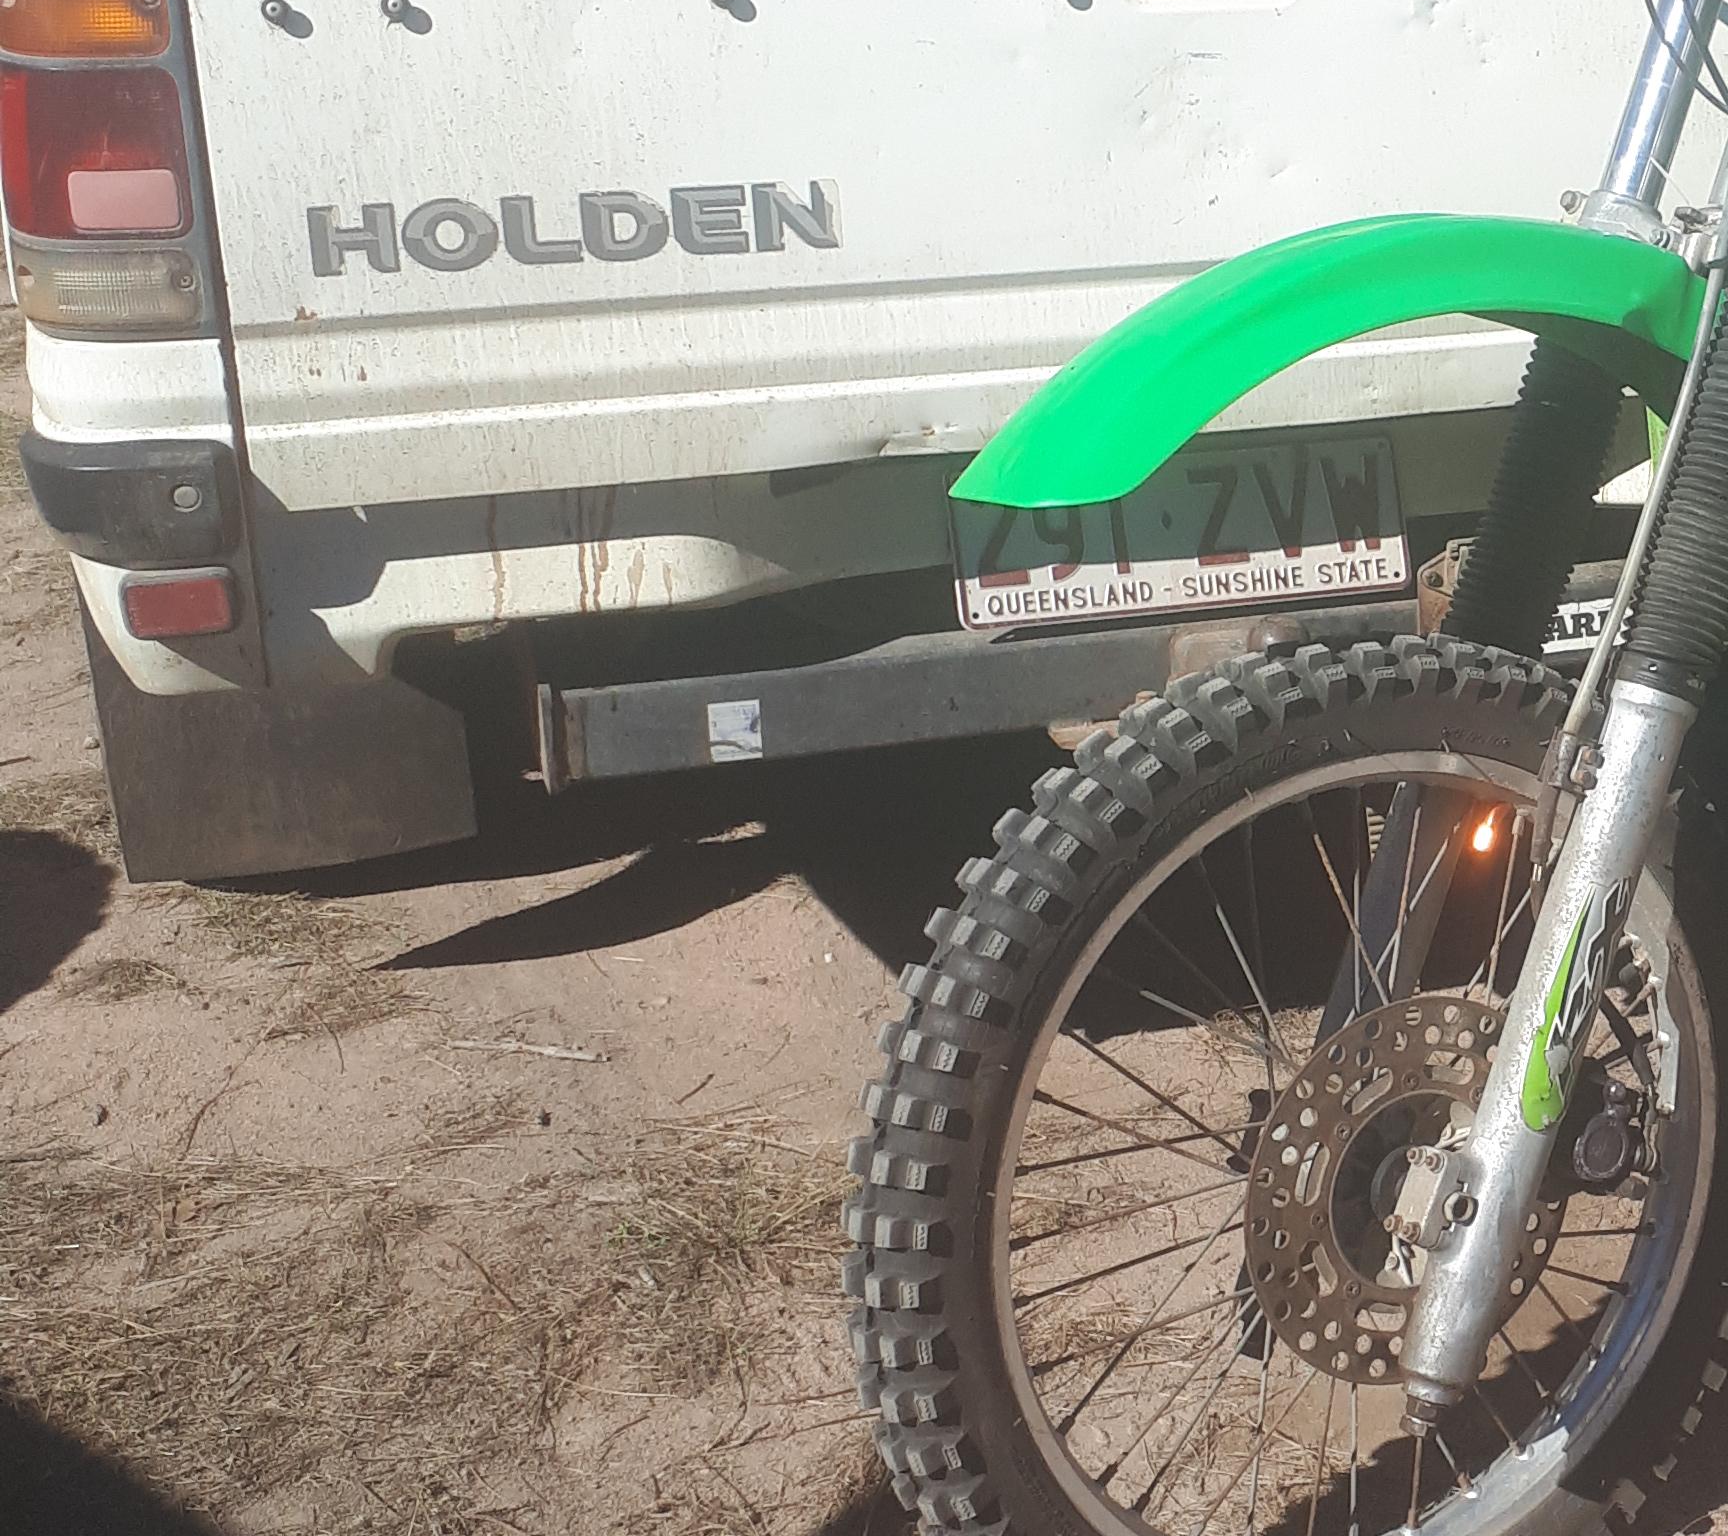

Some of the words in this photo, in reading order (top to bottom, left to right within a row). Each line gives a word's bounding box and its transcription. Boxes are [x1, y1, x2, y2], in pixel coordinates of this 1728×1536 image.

[306, 178, 843, 277] HOLDEN
[1186, 447, 1381, 565] ZVW
[986, 579, 1154, 617] QUEENSLAND
[1182, 563, 1305, 598] SUNSHINE
[1317, 557, 1389, 587] STATE
